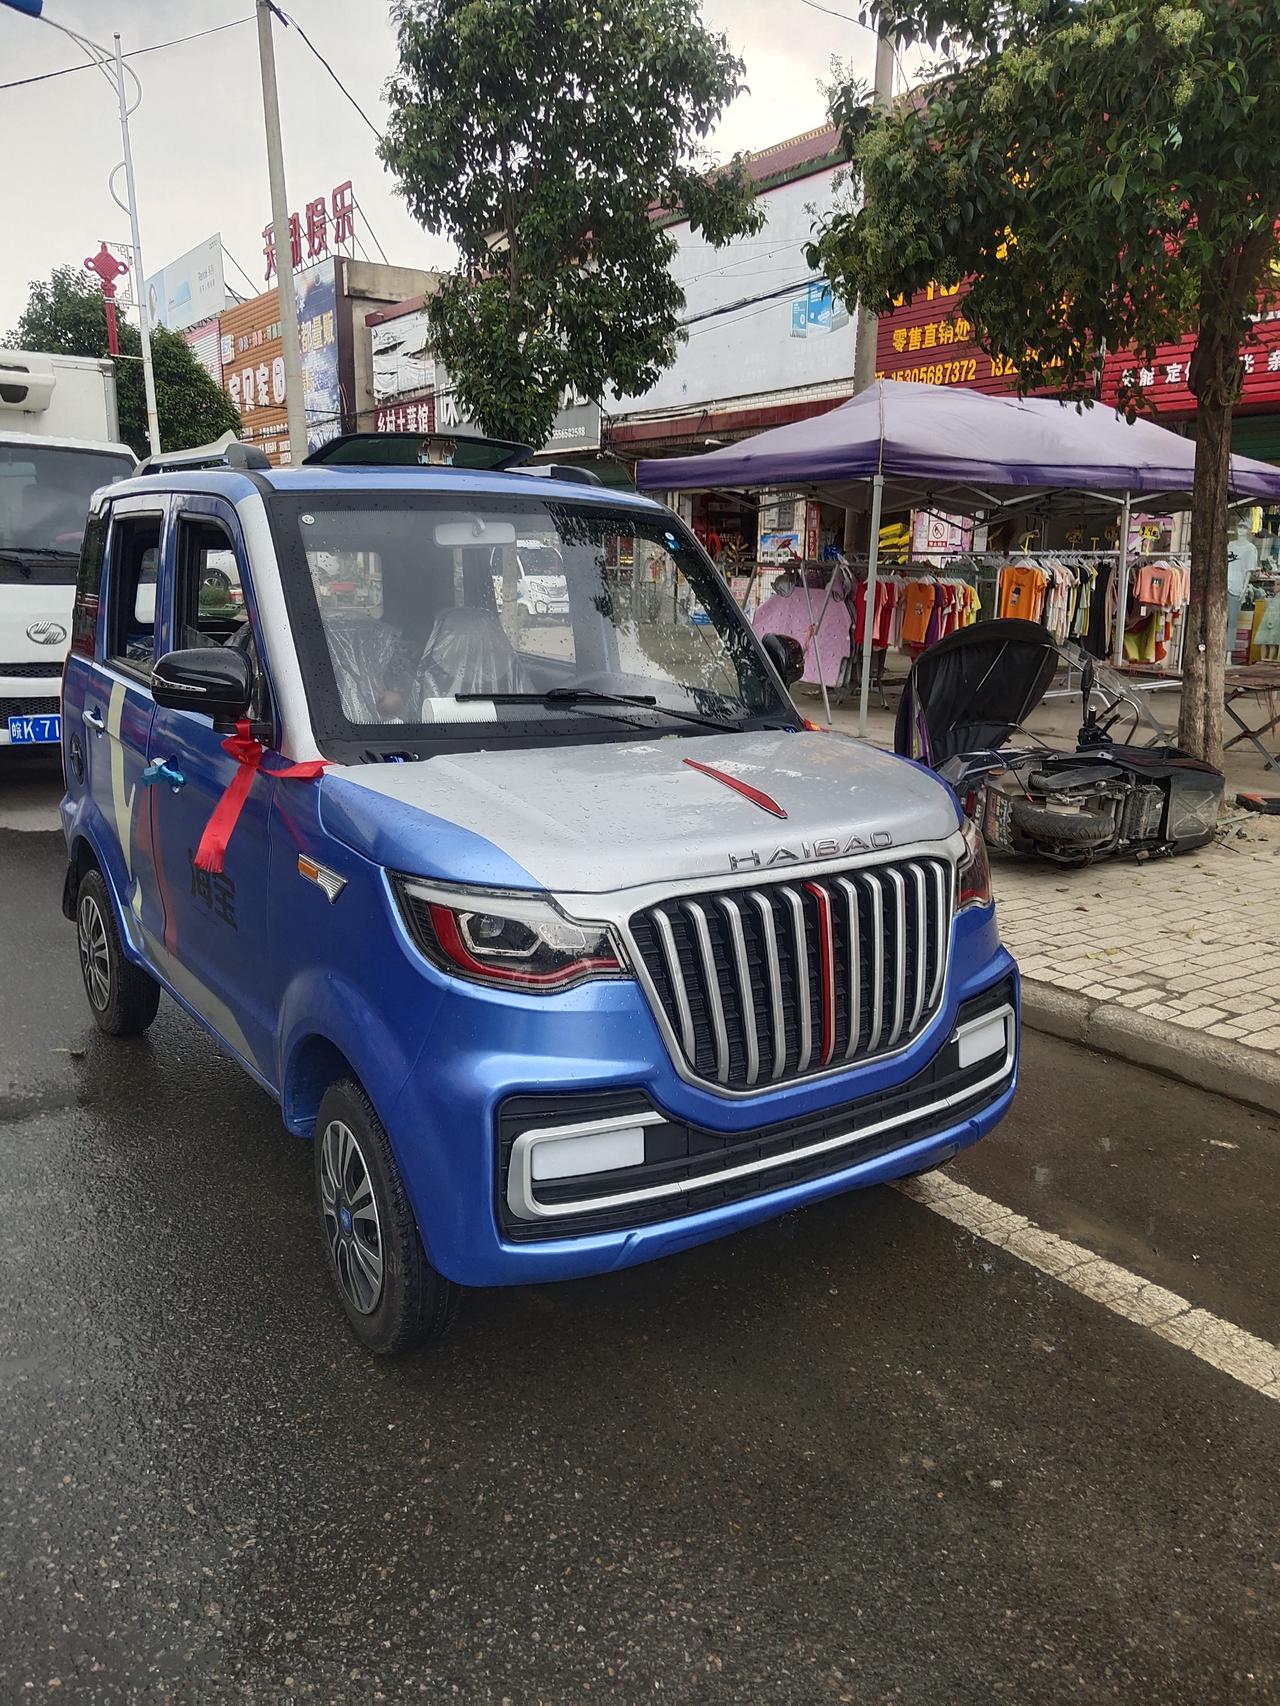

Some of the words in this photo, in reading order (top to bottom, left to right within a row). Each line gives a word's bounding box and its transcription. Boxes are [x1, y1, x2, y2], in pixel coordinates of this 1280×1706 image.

[298, 310, 335, 353] 都量贩
[893, 317, 970, 352] 零售直销处
[728, 830, 893, 871] HAIBAO
